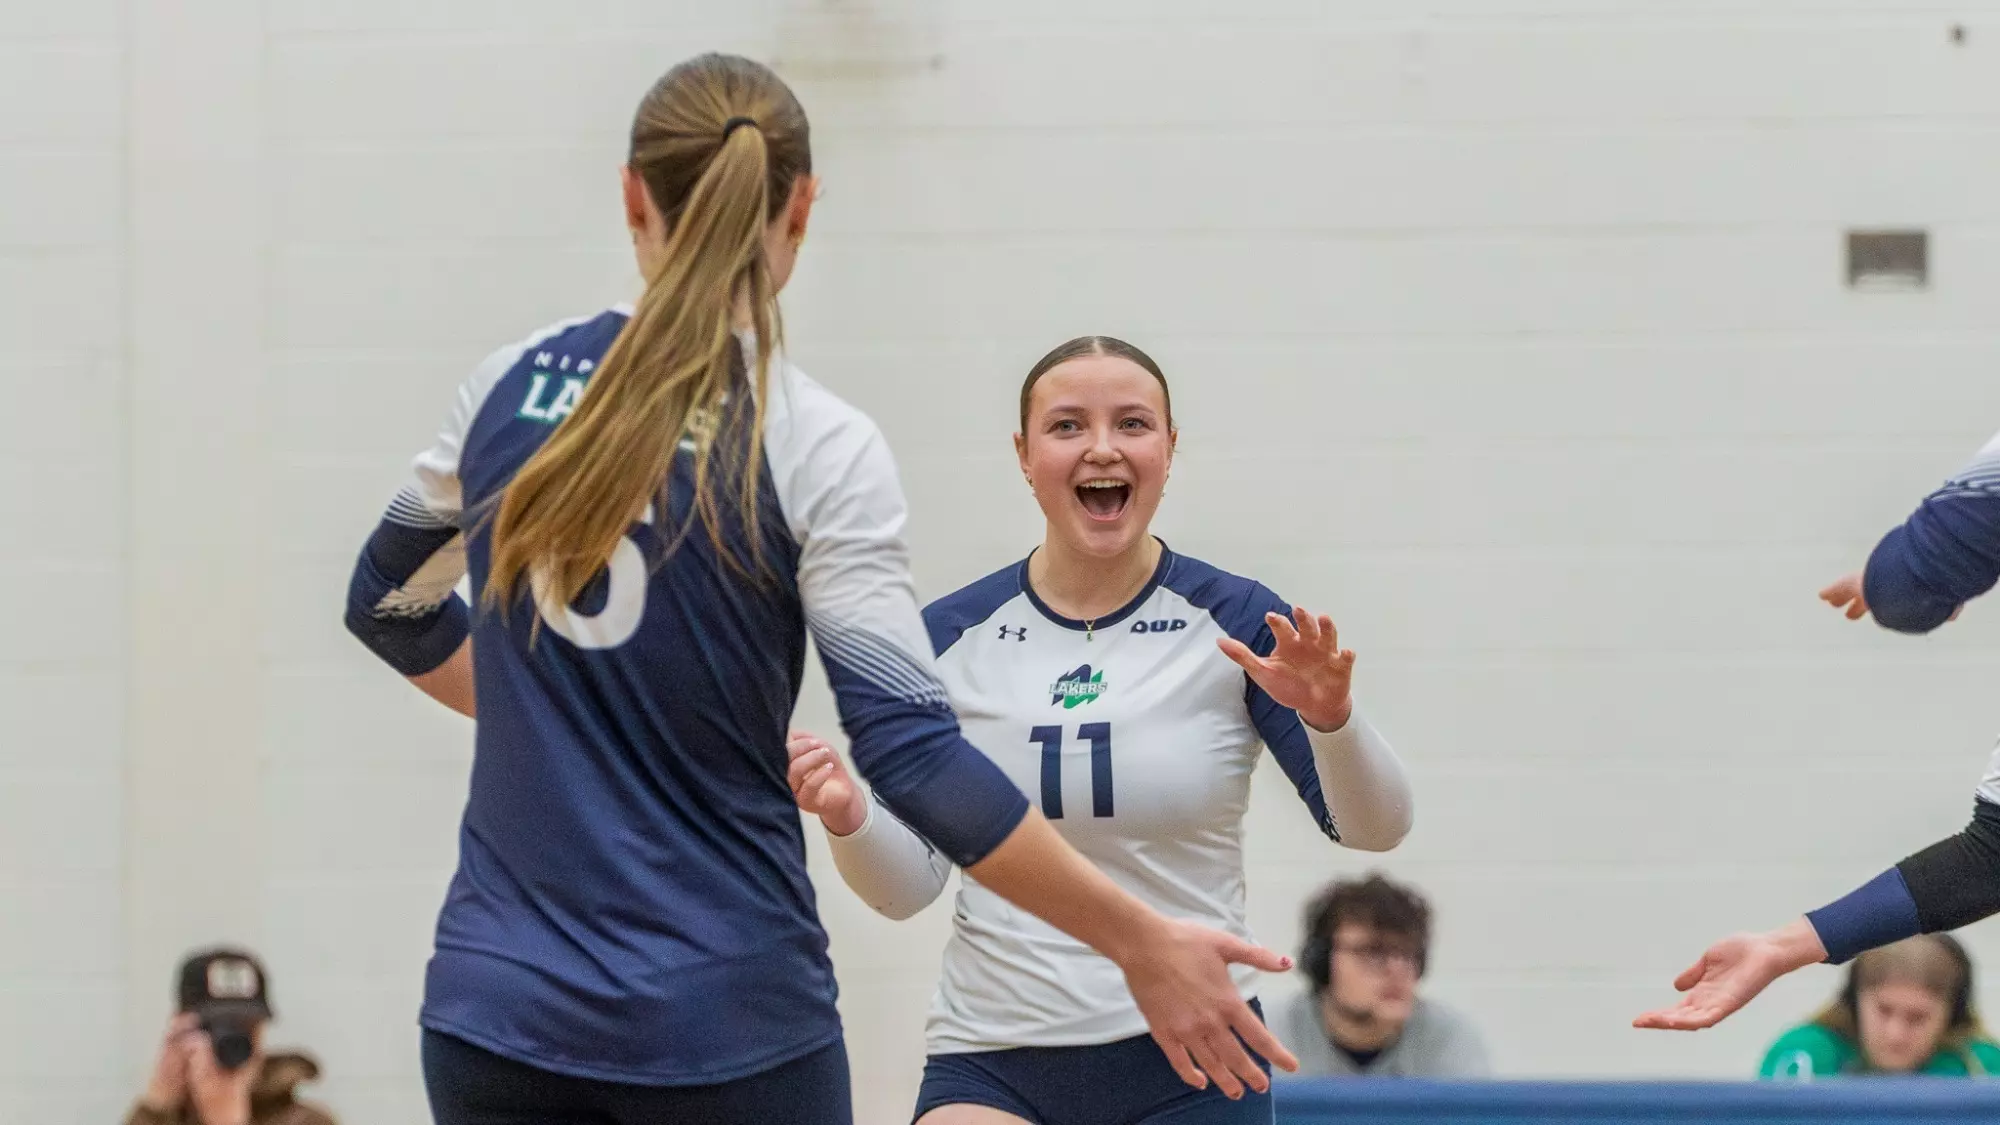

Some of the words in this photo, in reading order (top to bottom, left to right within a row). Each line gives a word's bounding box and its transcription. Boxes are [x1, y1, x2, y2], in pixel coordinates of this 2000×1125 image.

[534, 351, 595, 374] NIP
[1049, 681, 1108, 697] LAKERS
[1028, 721, 1114, 820] 11
